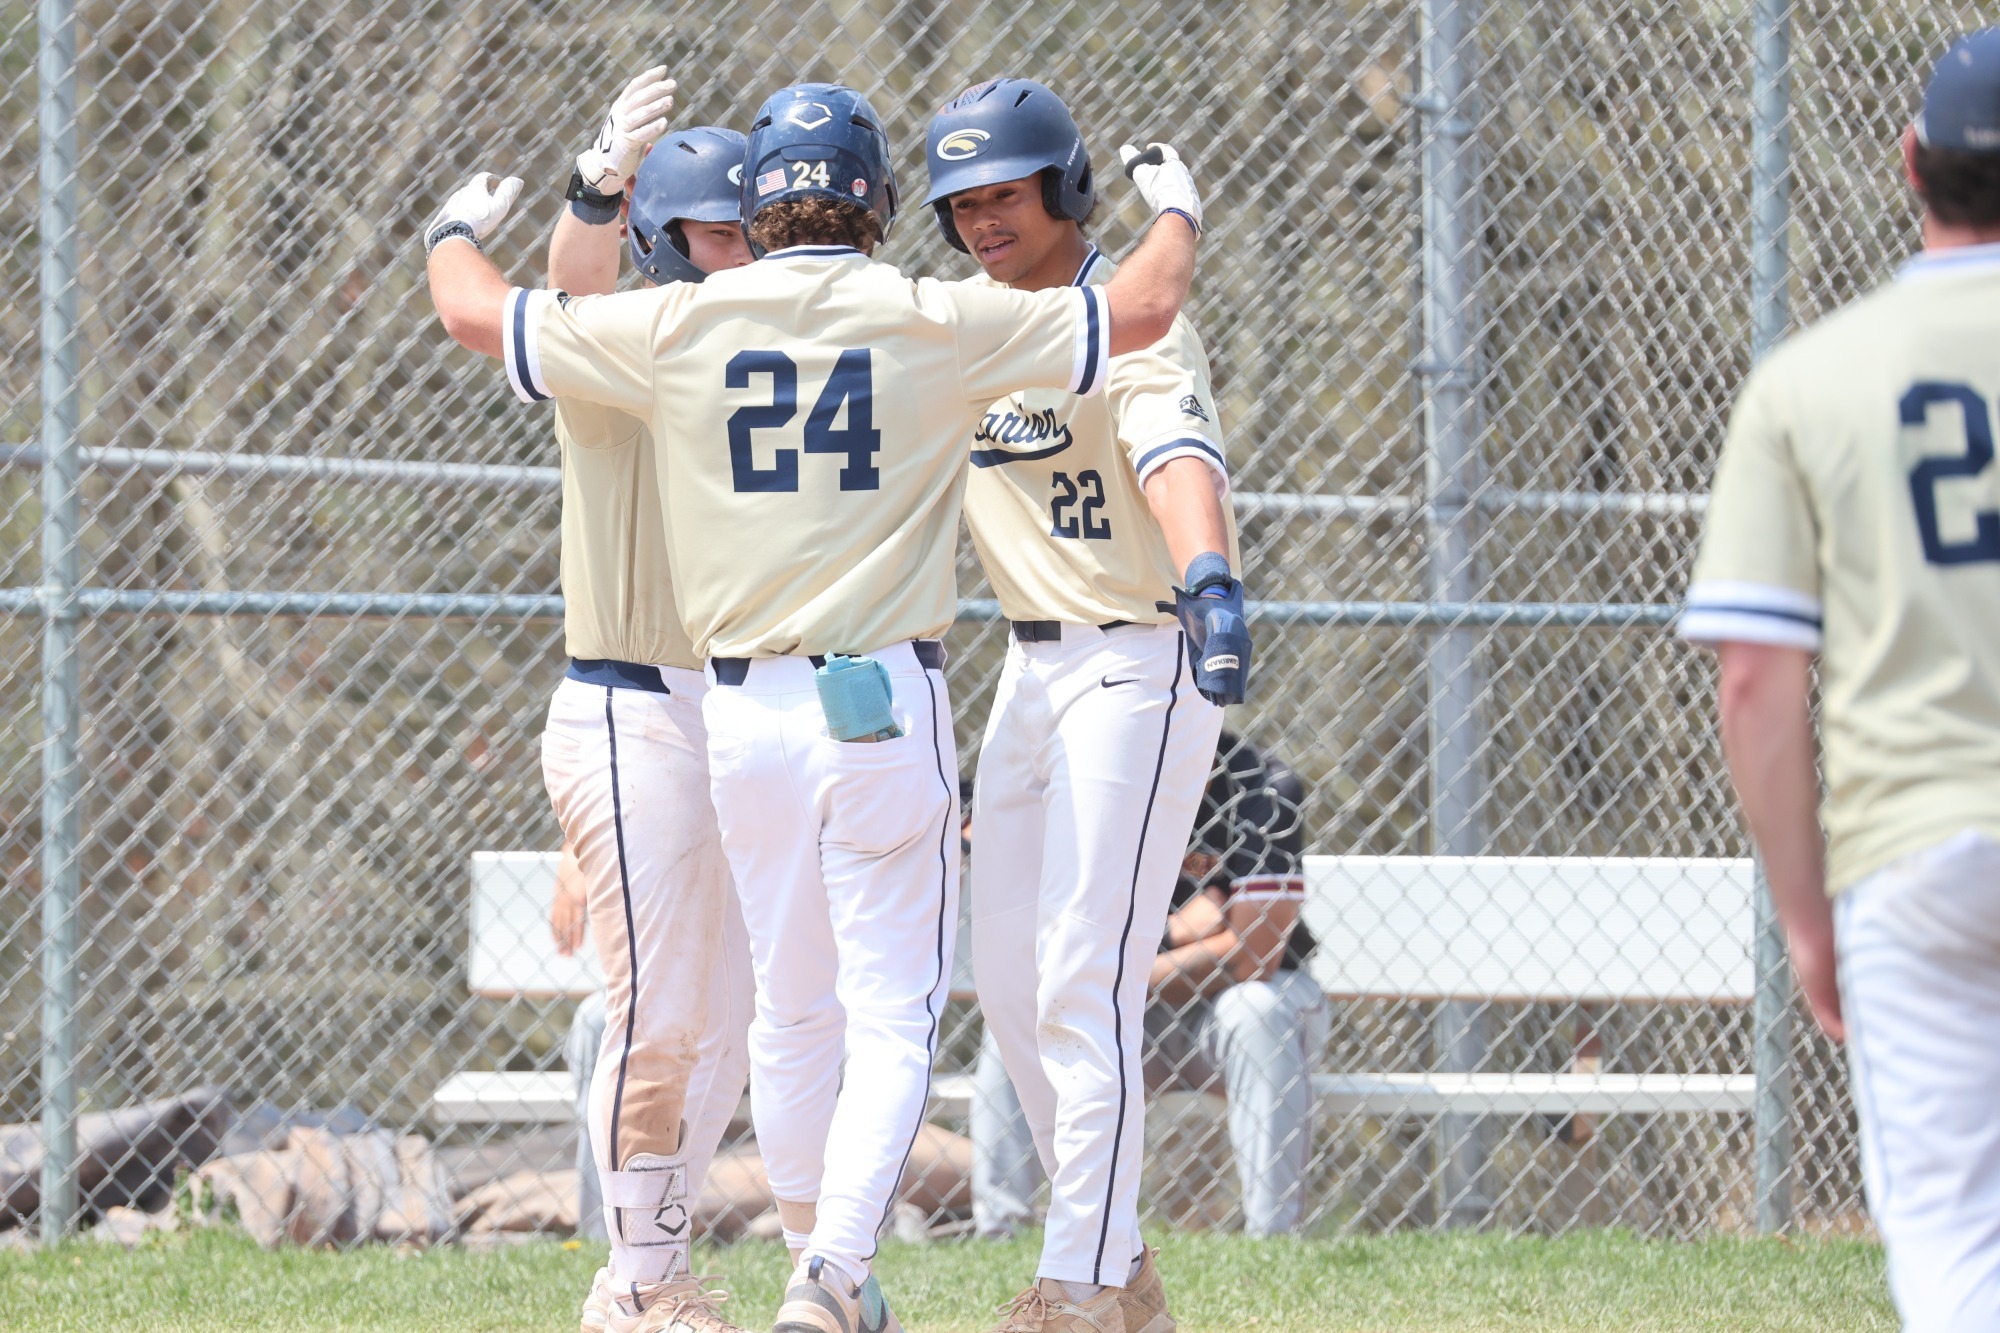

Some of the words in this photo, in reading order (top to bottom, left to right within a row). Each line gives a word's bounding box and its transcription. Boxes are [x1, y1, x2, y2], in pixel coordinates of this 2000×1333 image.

[791, 160, 831, 189] 24
[725, 348, 881, 492] 24
[975, 403, 1067, 444] arion
[1051, 470, 1111, 539] 22
[1898, 382, 2000, 566] 2
